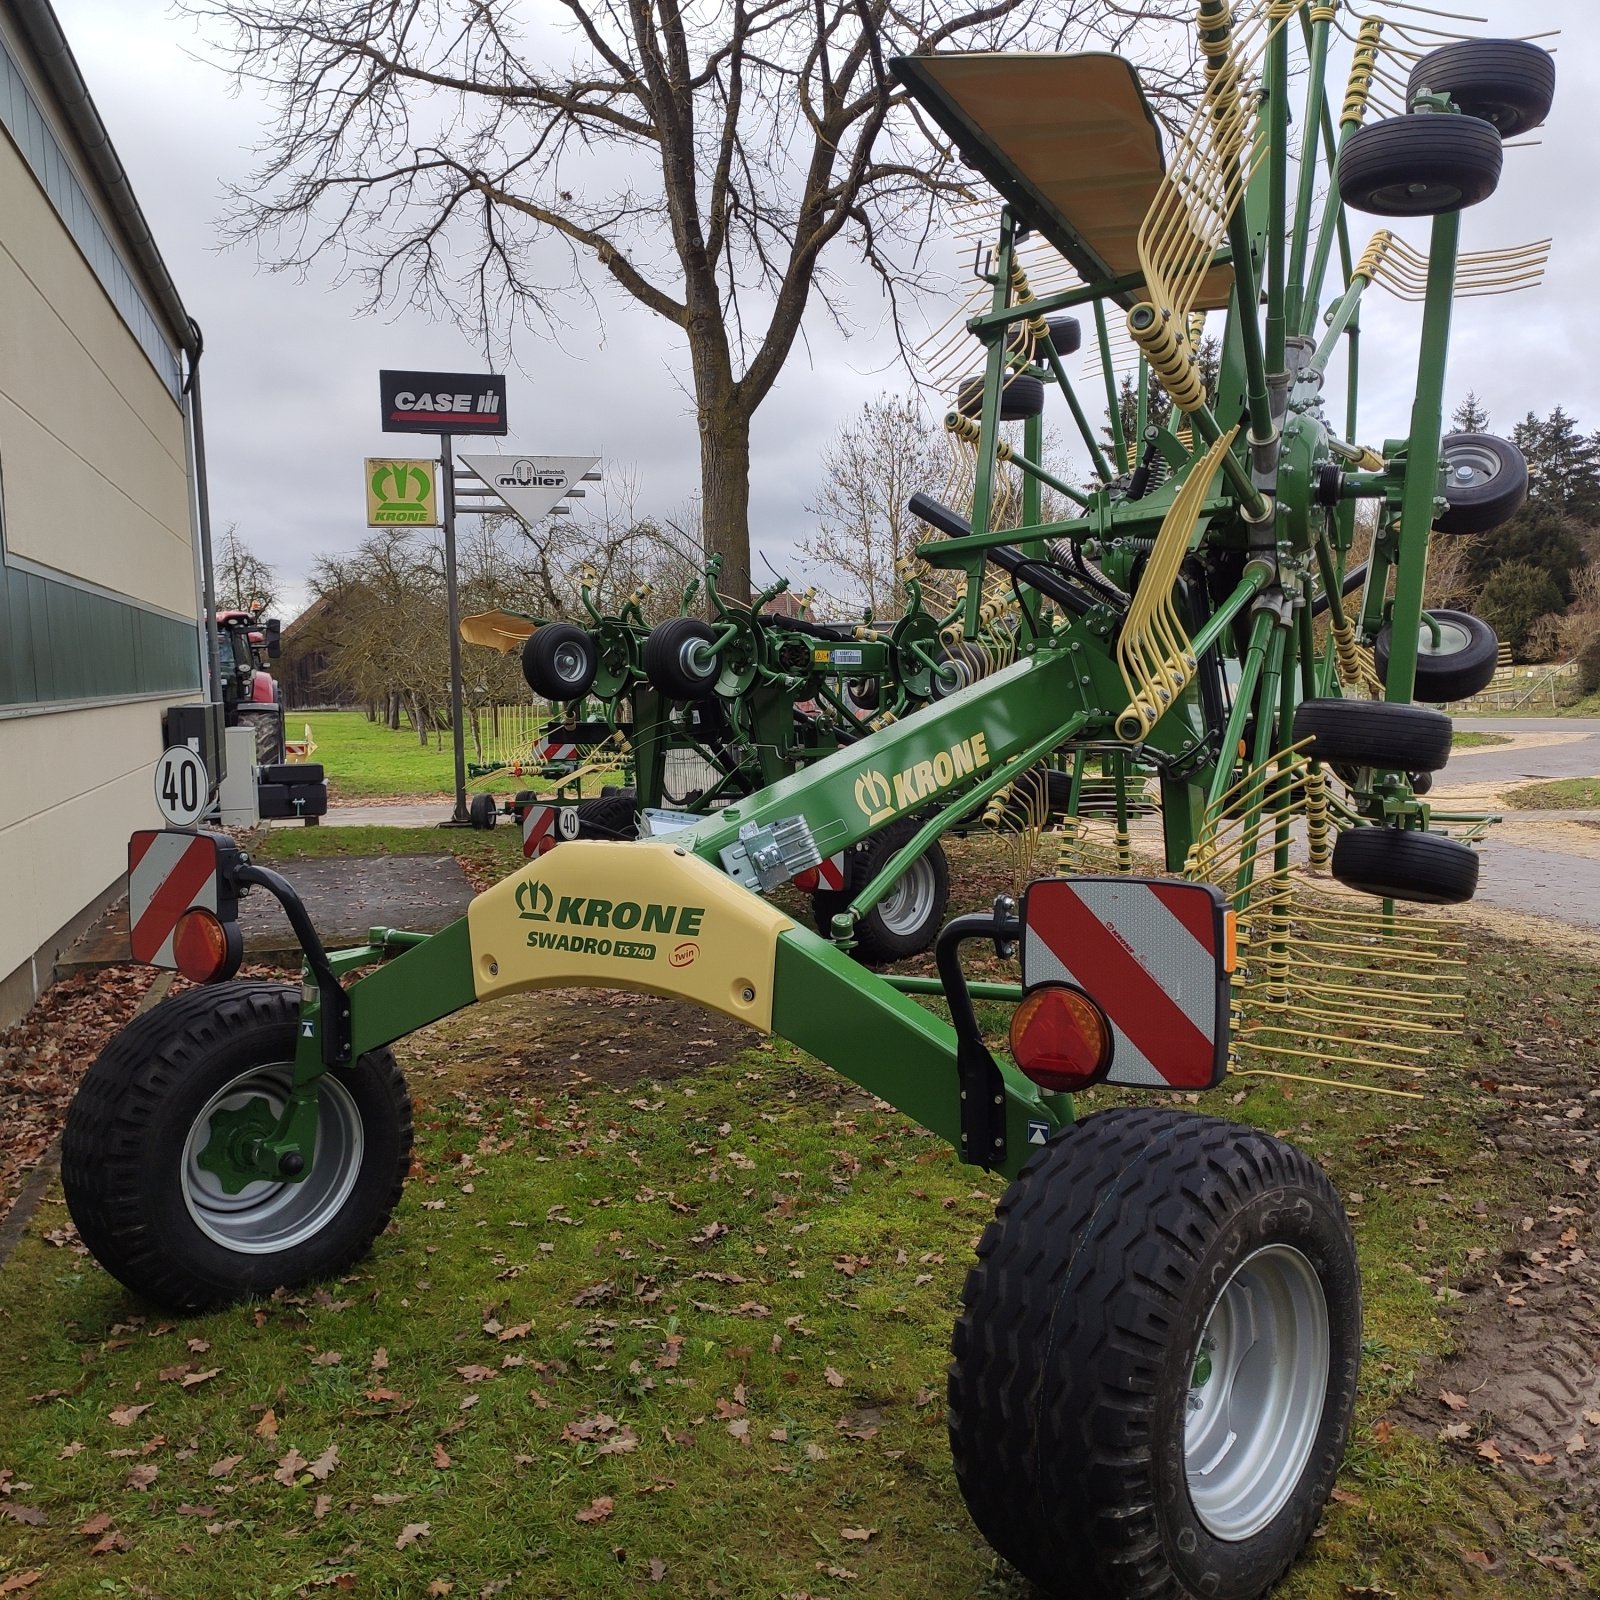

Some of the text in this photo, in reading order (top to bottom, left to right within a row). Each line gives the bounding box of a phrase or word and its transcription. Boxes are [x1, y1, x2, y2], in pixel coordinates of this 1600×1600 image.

[395, 391, 472, 412] CASE
[375, 512, 428, 522] KRONE
[893, 732, 990, 810] KRONE
[162, 760, 197, 812] 40
[563, 813, 576, 834] 40
[556, 896, 705, 936] KRONE
[527, 931, 651, 958] SWADRO TS 740
[674, 948, 694, 963] Twin
